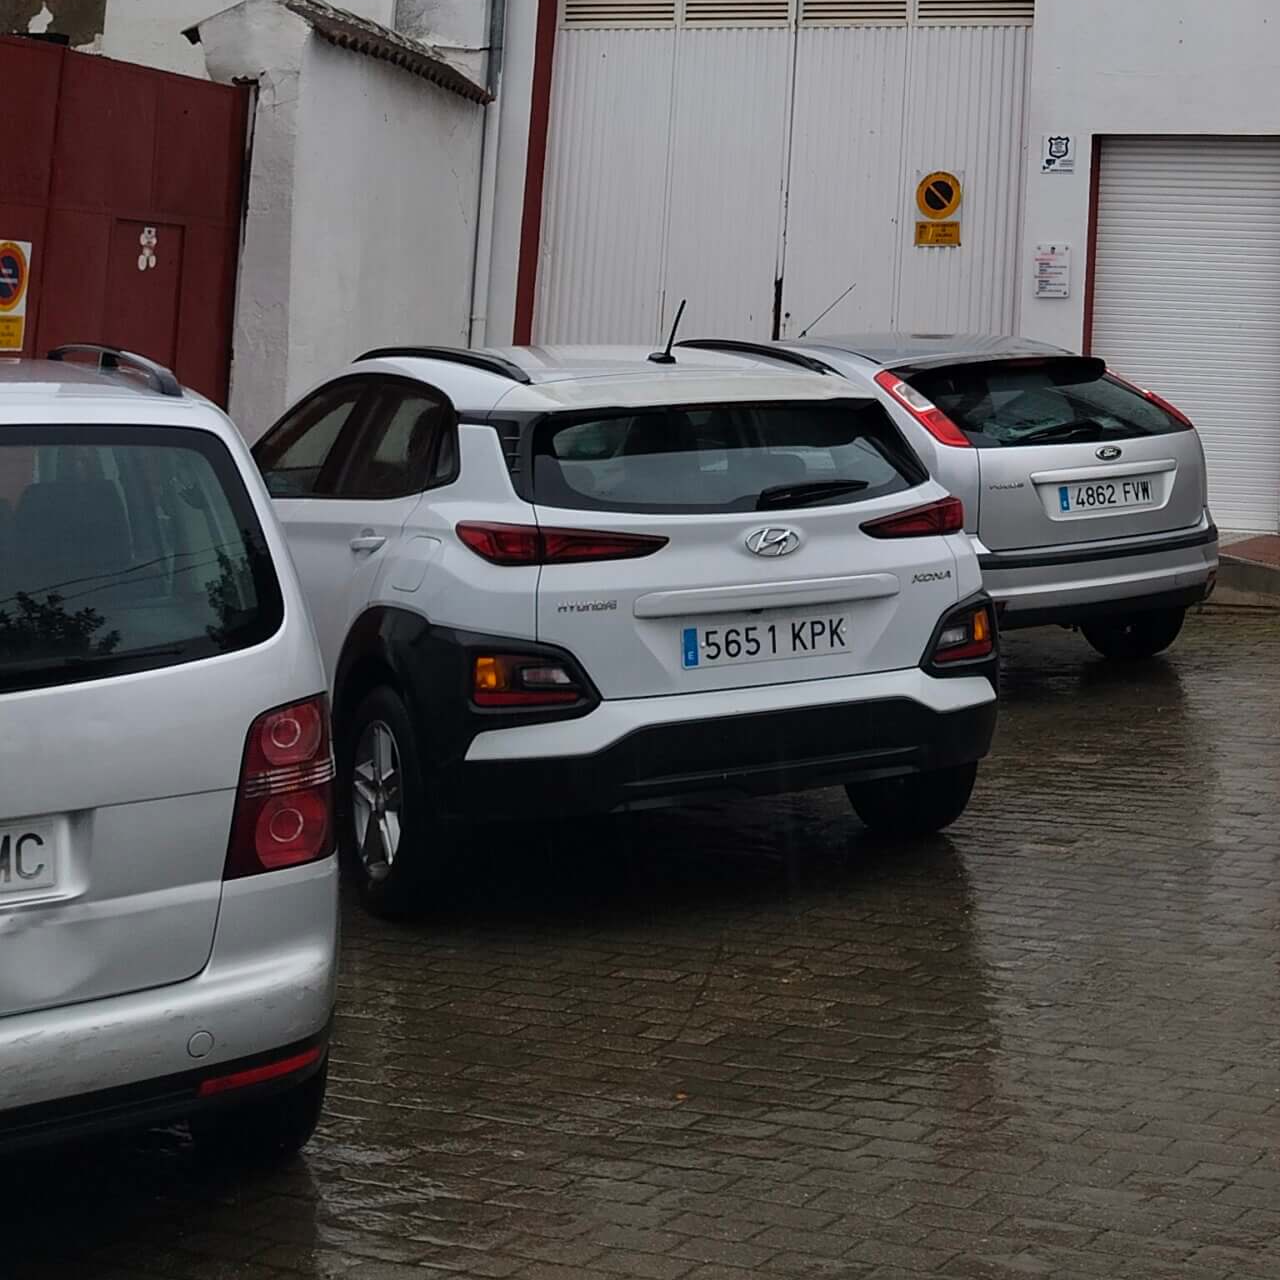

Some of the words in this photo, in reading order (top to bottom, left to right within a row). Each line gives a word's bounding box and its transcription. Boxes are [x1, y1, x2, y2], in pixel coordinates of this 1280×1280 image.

[1075, 483, 1118, 508] 4862
[1122, 480, 1151, 503] FVW
[705, 625, 777, 660] 5651
[791, 617, 846, 652] KPK
